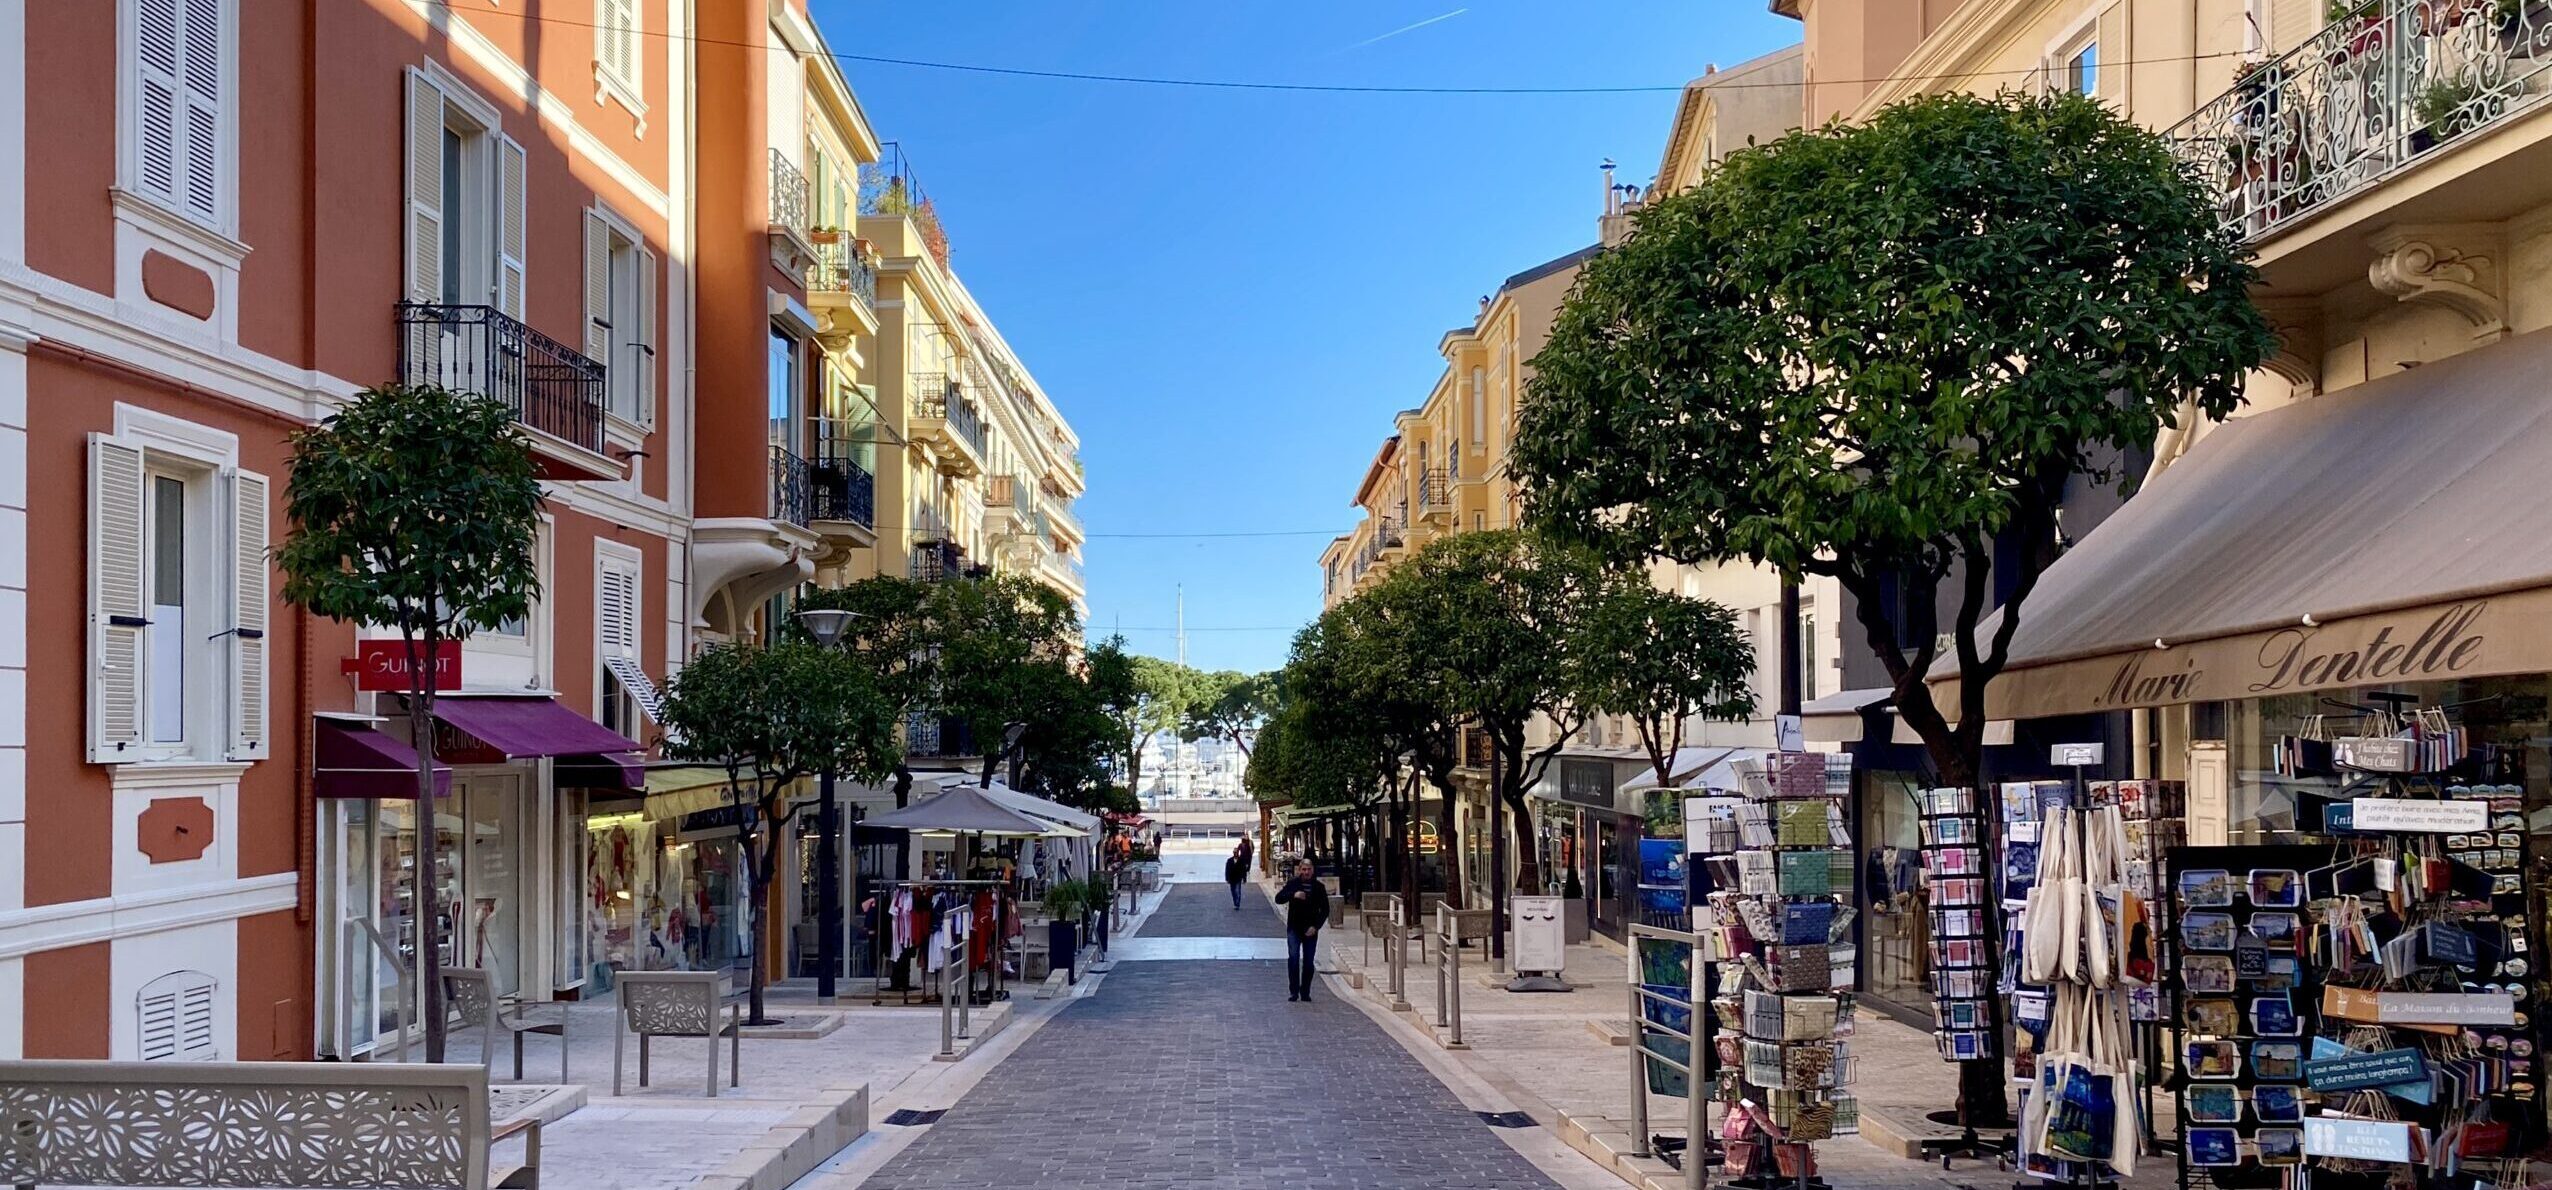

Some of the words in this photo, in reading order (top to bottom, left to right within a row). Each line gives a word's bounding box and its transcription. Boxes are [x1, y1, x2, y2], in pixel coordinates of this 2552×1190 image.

[2093, 651, 2203, 705] Marie
[2248, 600, 2489, 692] Dentelle
[442, 726, 487, 750] GUINO
[2332, 814, 2353, 826] Int
